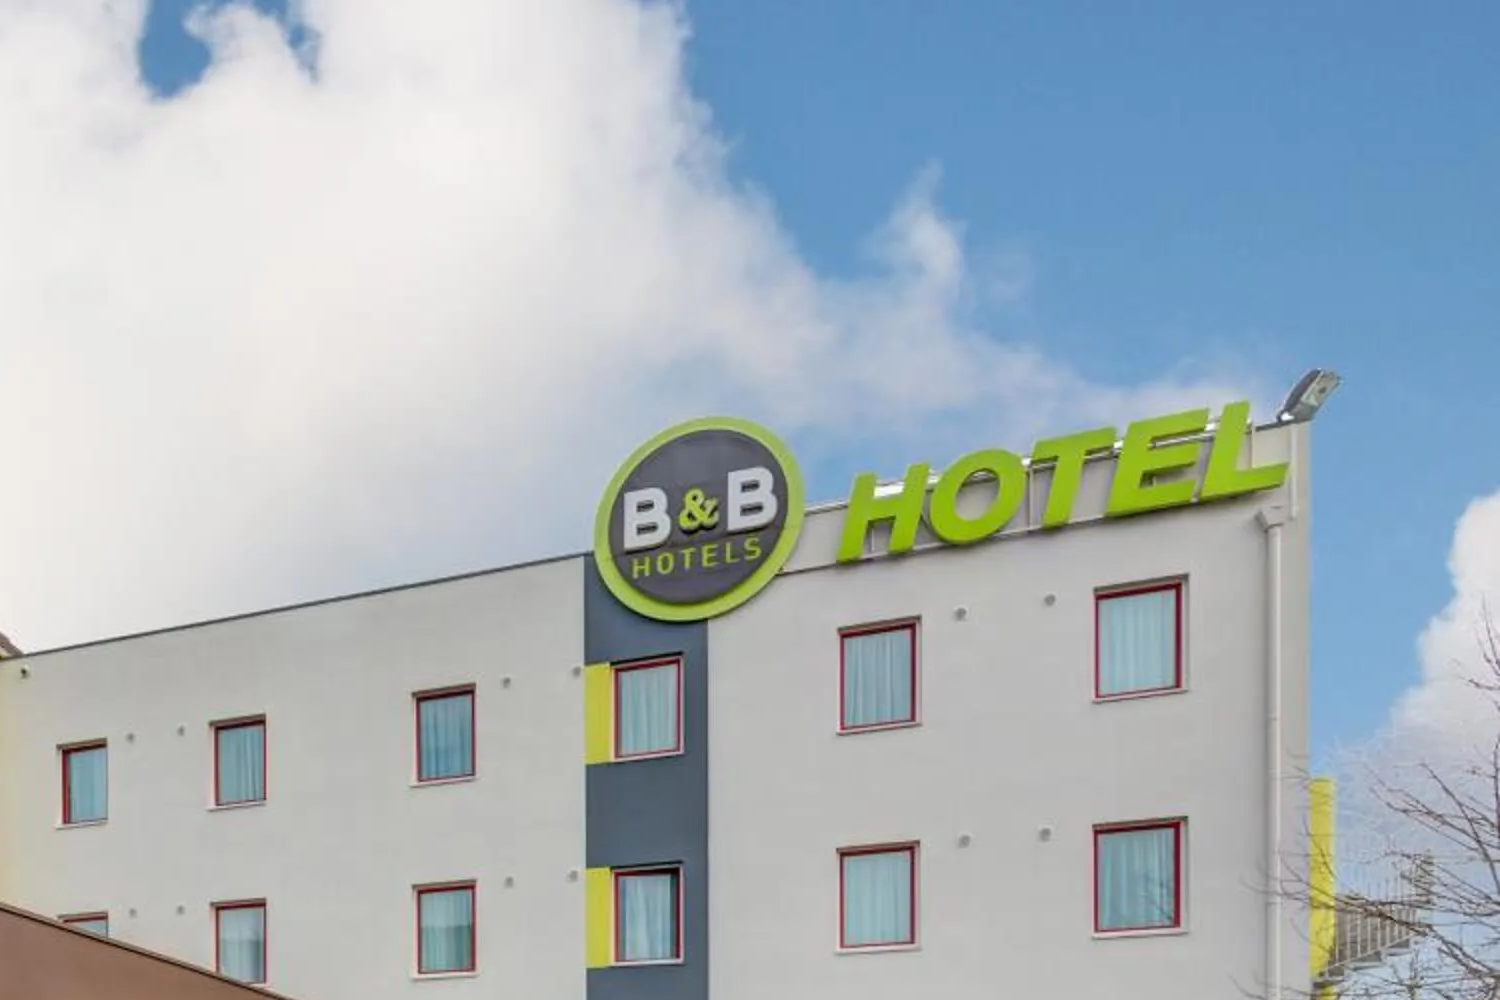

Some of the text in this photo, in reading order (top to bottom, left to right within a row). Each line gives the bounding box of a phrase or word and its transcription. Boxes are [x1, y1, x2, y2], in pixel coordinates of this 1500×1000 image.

[623, 466, 778, 549] B&B
[837, 402, 1288, 564] HOTEL
[632, 537, 763, 579] HOTELS
